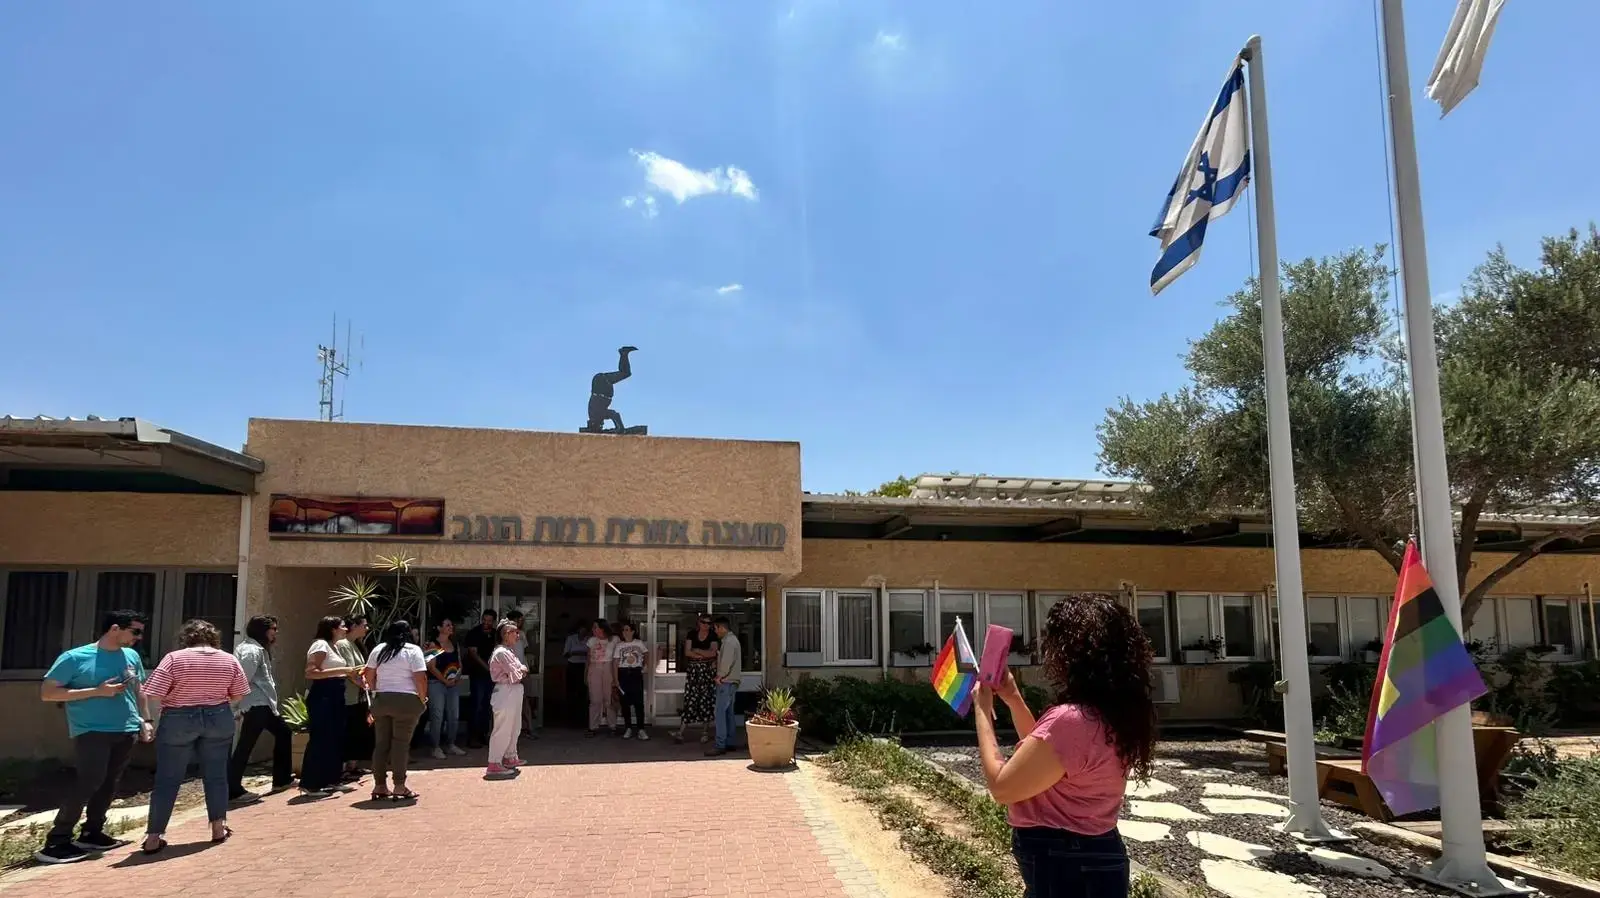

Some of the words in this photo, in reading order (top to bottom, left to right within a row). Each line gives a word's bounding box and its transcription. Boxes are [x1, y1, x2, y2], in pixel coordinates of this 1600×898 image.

[452, 515, 522, 541] הנגב
[535, 515, 595, 542] רמת
[605, 517, 690, 544] אזורית
[702, 520, 786, 546] מועצה
